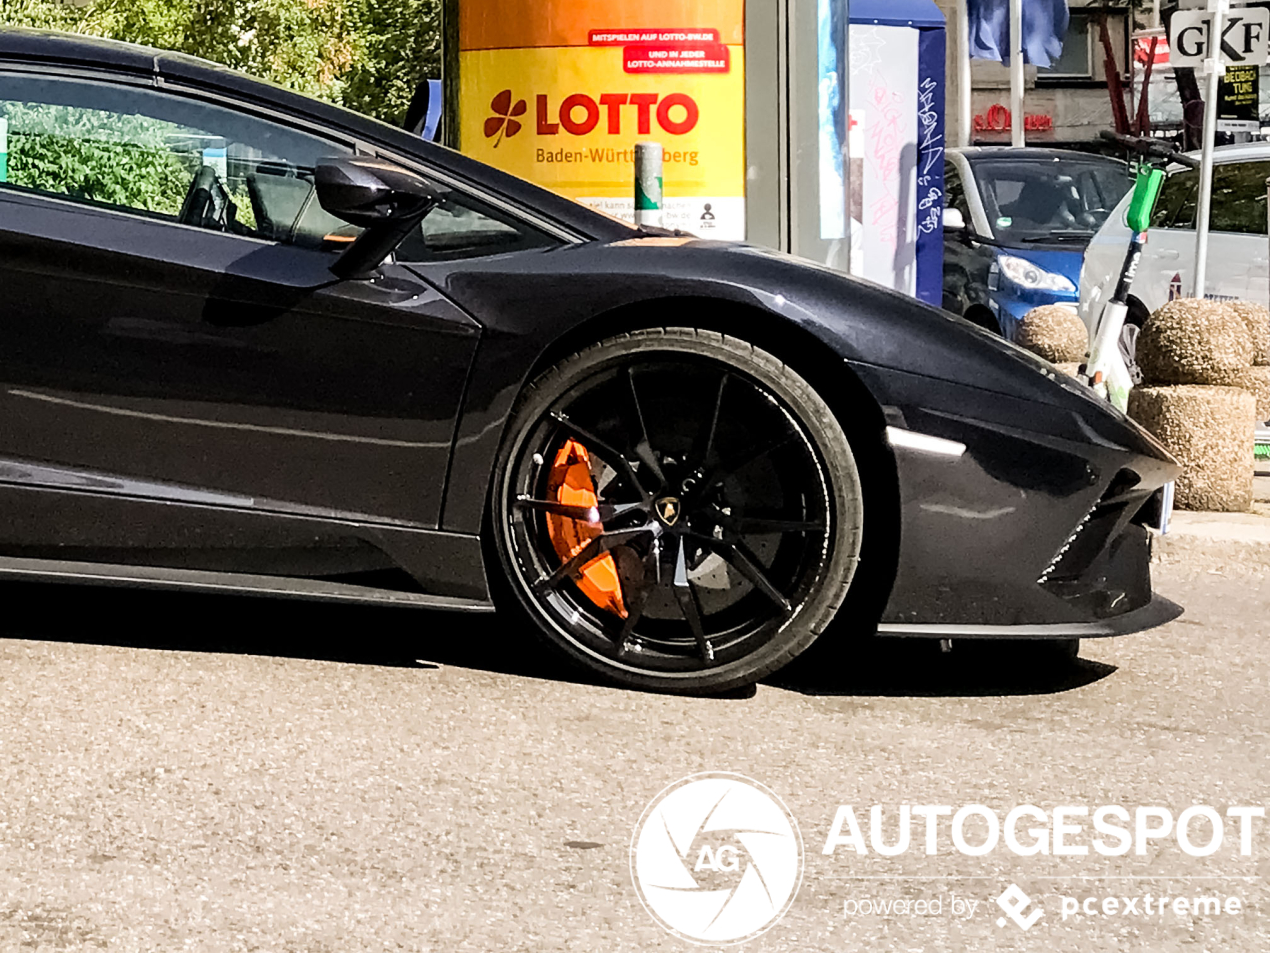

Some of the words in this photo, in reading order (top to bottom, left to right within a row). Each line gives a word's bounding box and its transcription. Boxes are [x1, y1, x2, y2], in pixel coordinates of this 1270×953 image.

[592, 33, 640, 42] MITSPIELEN
[640, 33, 658, 41] AUF
[1177, 17, 1263, 62] GKF
[627, 60, 726, 68] LOTTO-ANNAHMESTELLE
[648, 50, 668, 59] UND
[669, 50, 679, 58] IN
[679, 50, 706, 58] JEDER
[536, 92, 700, 136] LOTTO
[1123, 251, 1142, 283] Lime
